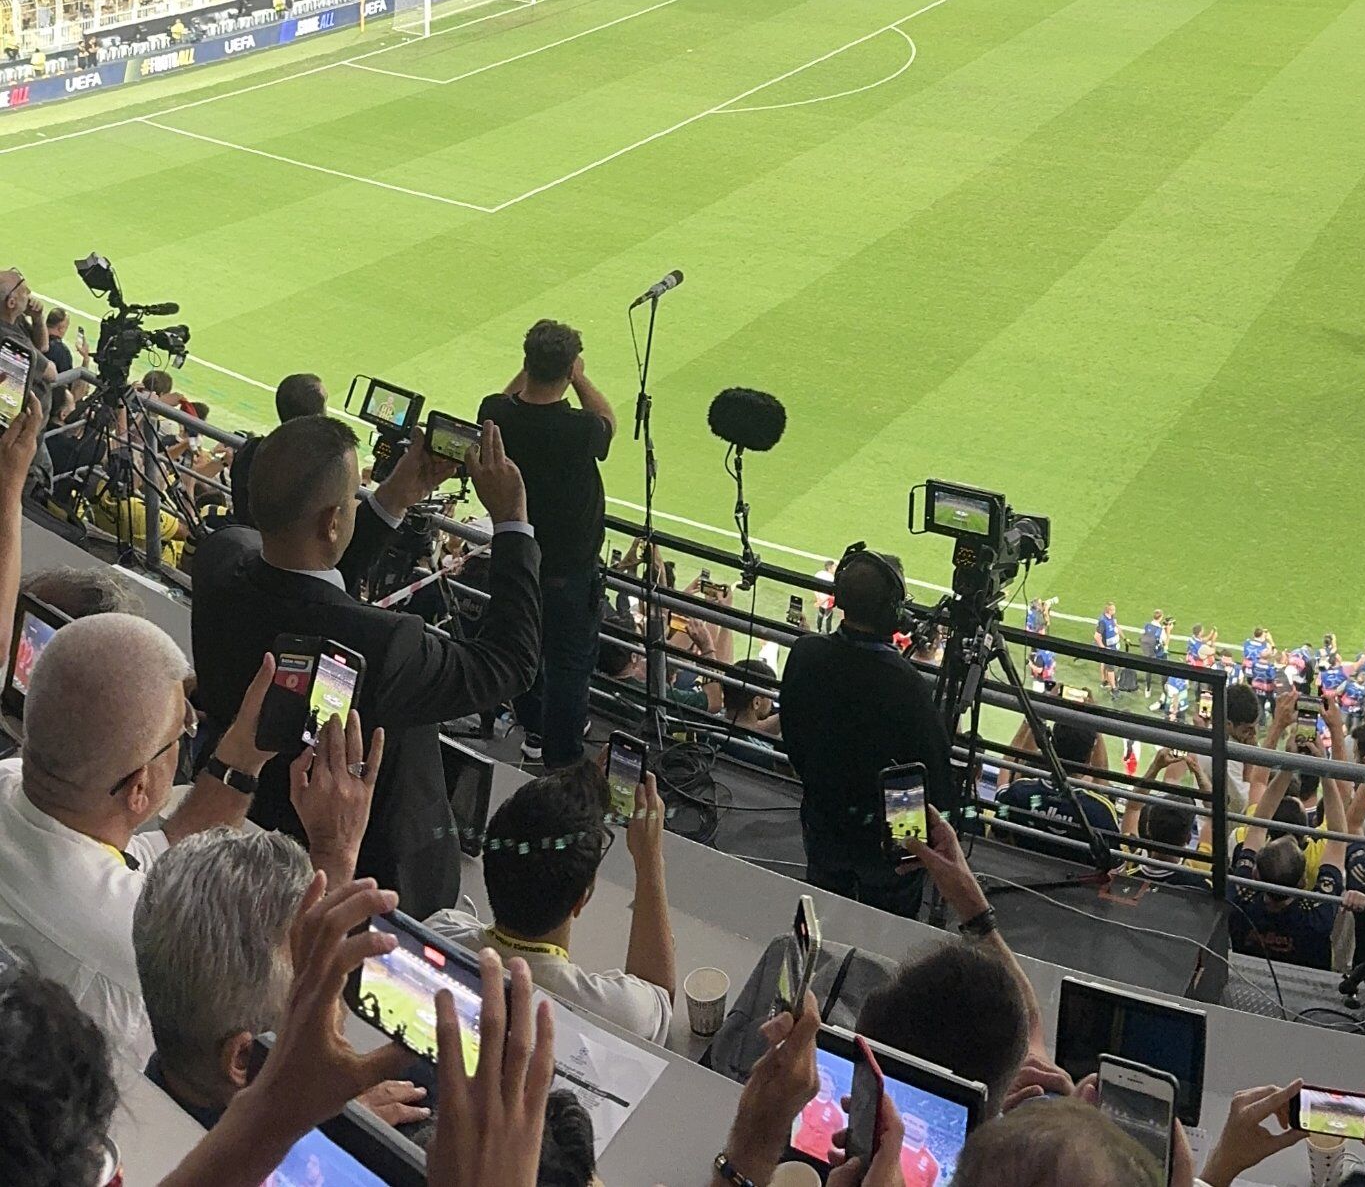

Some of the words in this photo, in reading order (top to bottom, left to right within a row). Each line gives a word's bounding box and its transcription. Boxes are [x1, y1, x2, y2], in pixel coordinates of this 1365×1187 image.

[225, 35, 256, 54] UEFA
[140, 49, 195, 76] #FOOTBALL
[65, 72, 102, 92] UEFA
